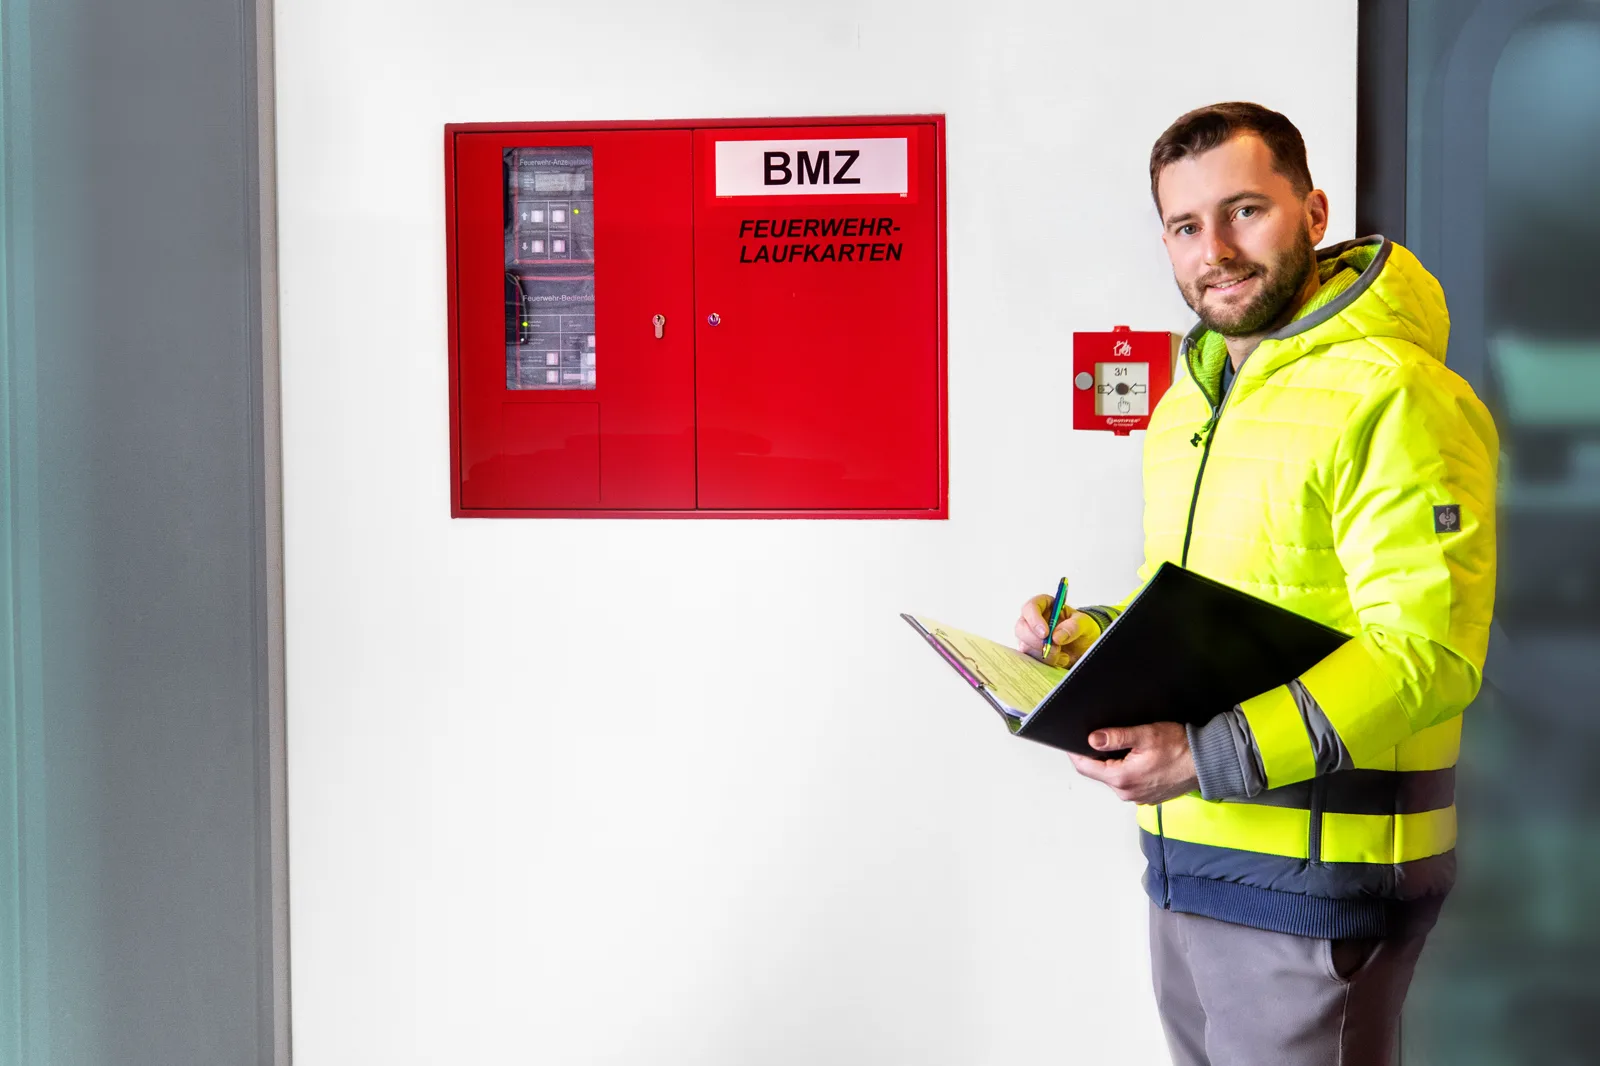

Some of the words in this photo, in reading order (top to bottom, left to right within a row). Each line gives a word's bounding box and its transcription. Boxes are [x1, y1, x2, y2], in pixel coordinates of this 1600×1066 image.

[763, 150, 861, 186] BMZ
[739, 218, 901, 238] FEUERWEHR-
[739, 243, 903, 263] LAUFKARTEN
[1114, 367, 1128, 377] 3/1
